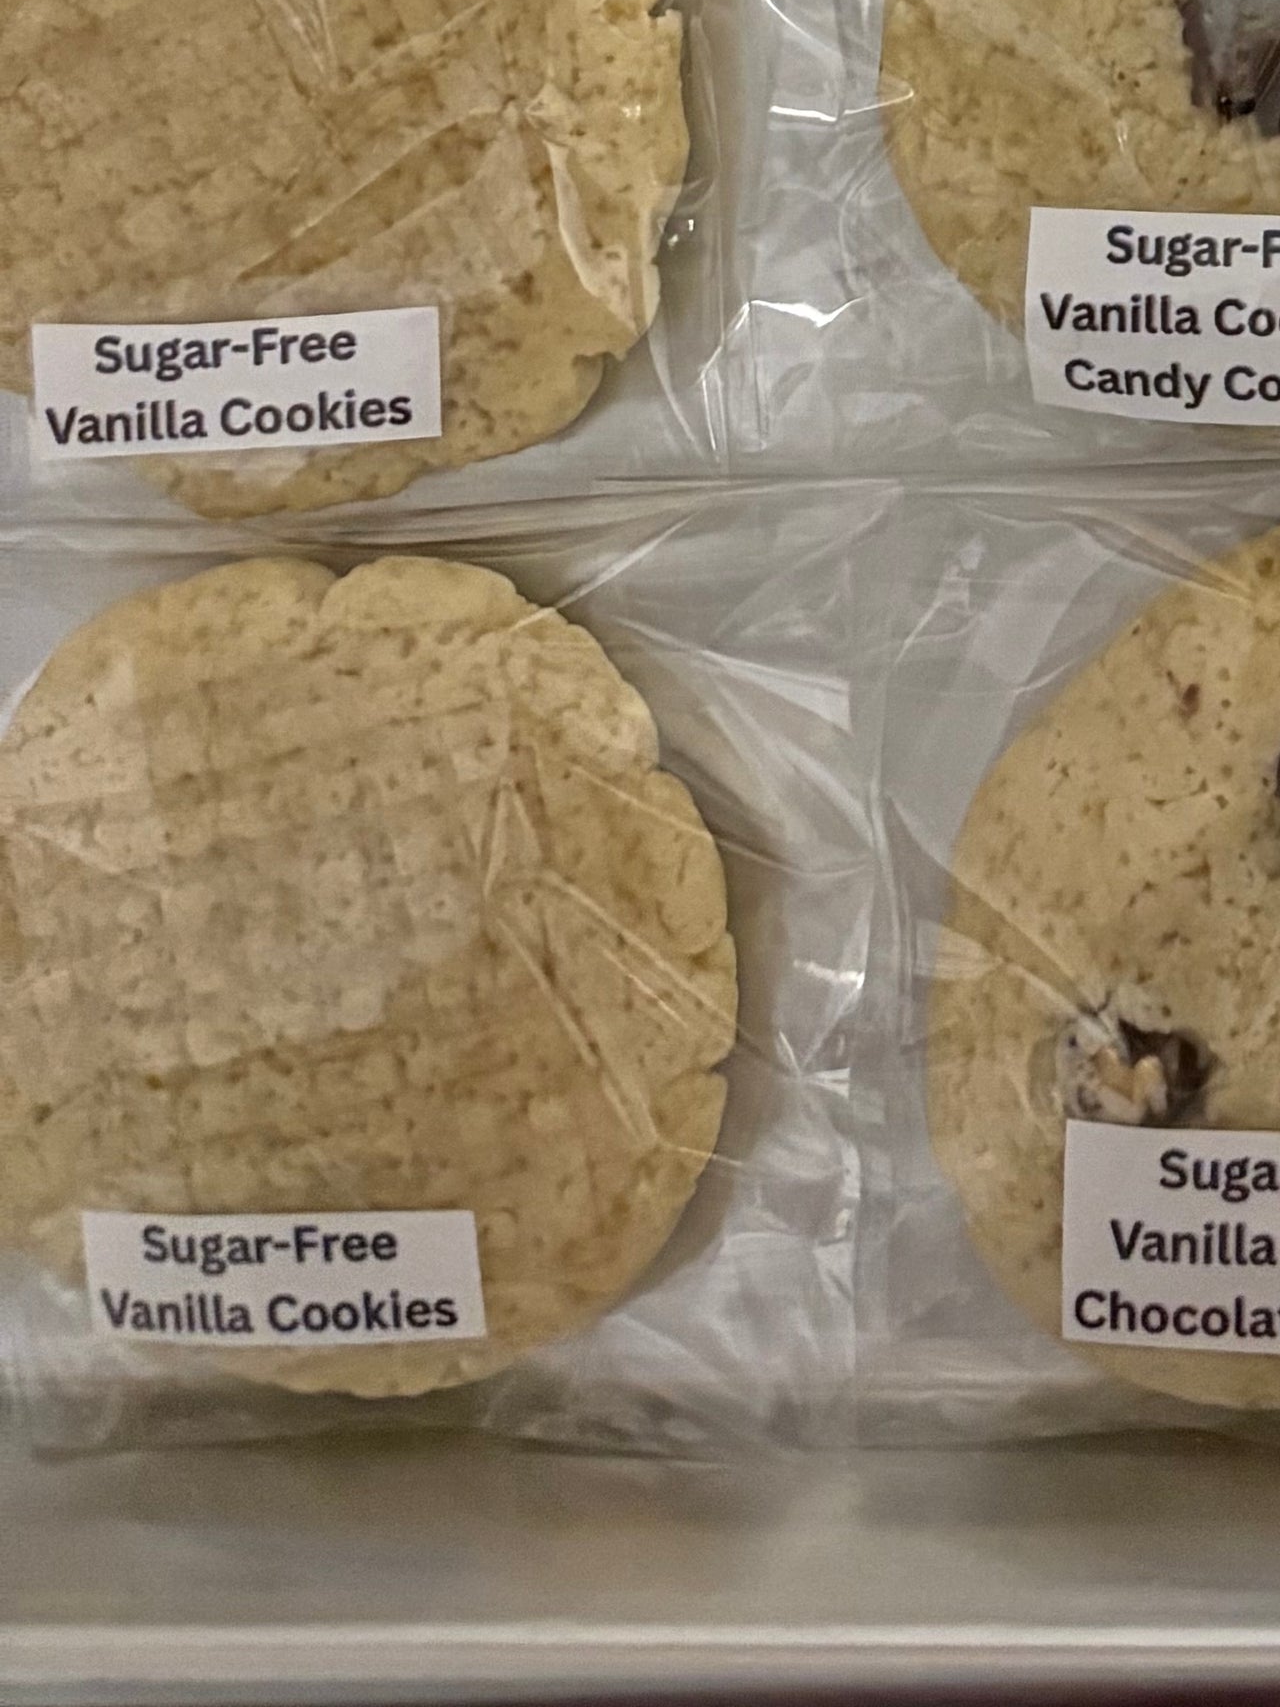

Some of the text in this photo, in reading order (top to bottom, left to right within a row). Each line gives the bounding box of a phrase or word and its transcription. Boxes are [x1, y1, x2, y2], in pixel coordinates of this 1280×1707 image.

[1039, 292, 1202, 336] Vanilla
[94, 327, 357, 383] Sugar-Free
[1064, 358, 1212, 410] Candy
[44, 388, 413, 446] Vanilla Cookies
[142, 1224, 398, 1277] Sugar-Free
[1109, 1218, 1278, 1267] Vanilla
[101, 1288, 459, 1335] Vanilla Cookies
